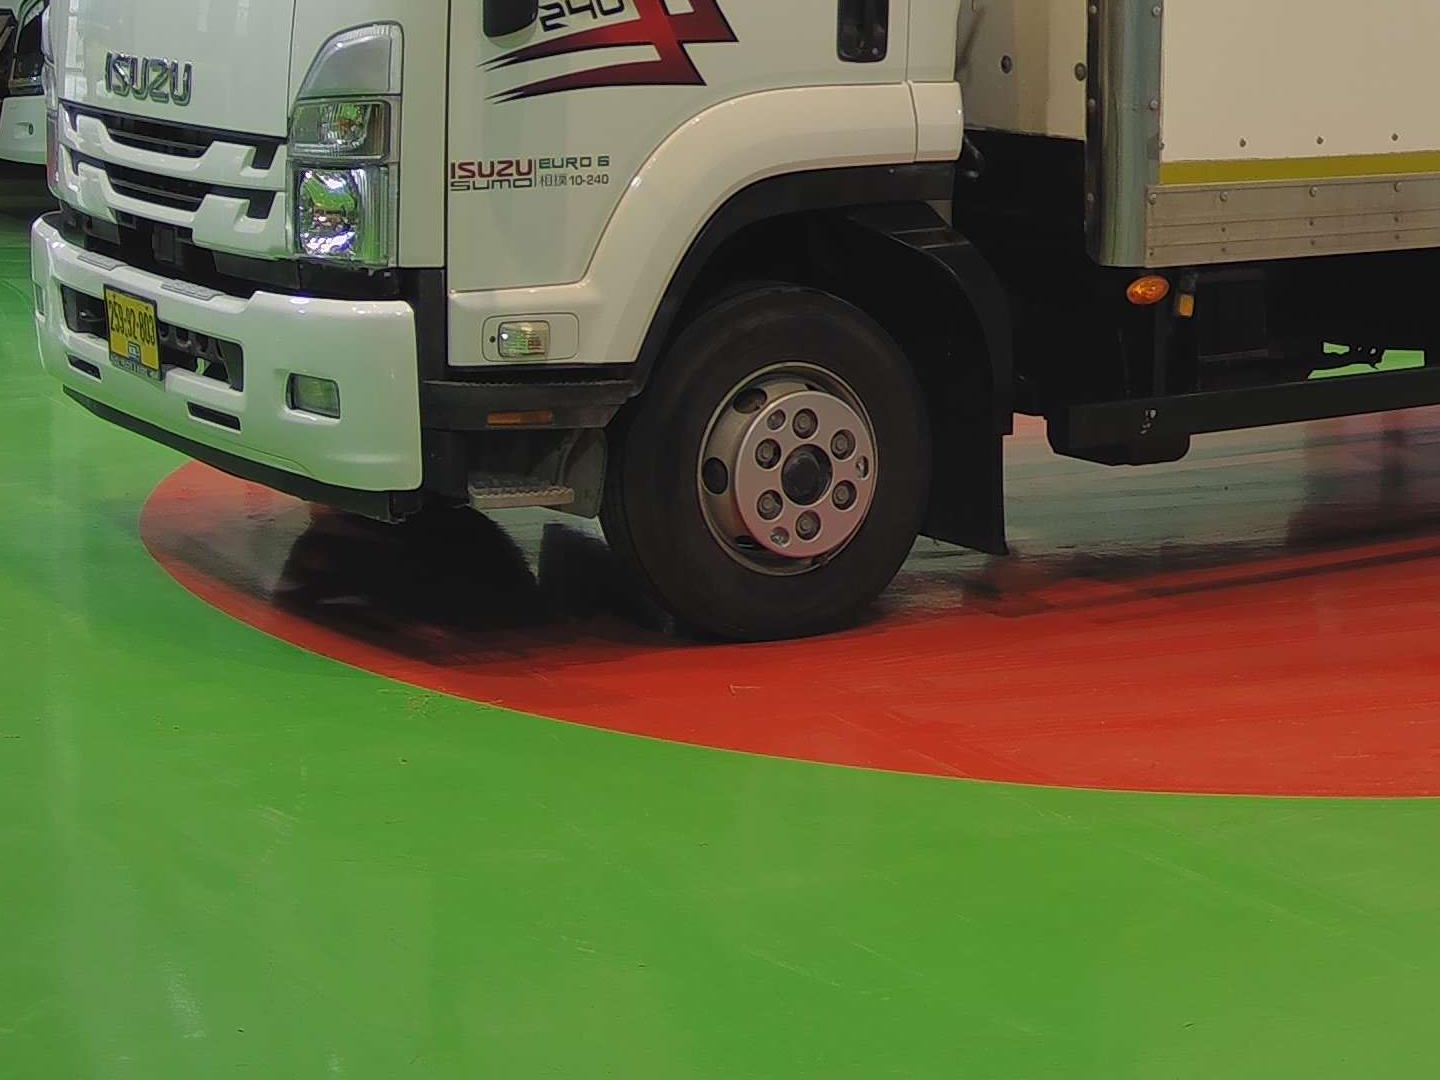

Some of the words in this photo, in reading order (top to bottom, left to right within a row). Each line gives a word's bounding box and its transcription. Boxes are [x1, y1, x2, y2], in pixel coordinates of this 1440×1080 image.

[105, 50, 192, 107] ISUZU
[450, 158, 533, 179] ISUZU
[539, 157, 592, 170] EURO
